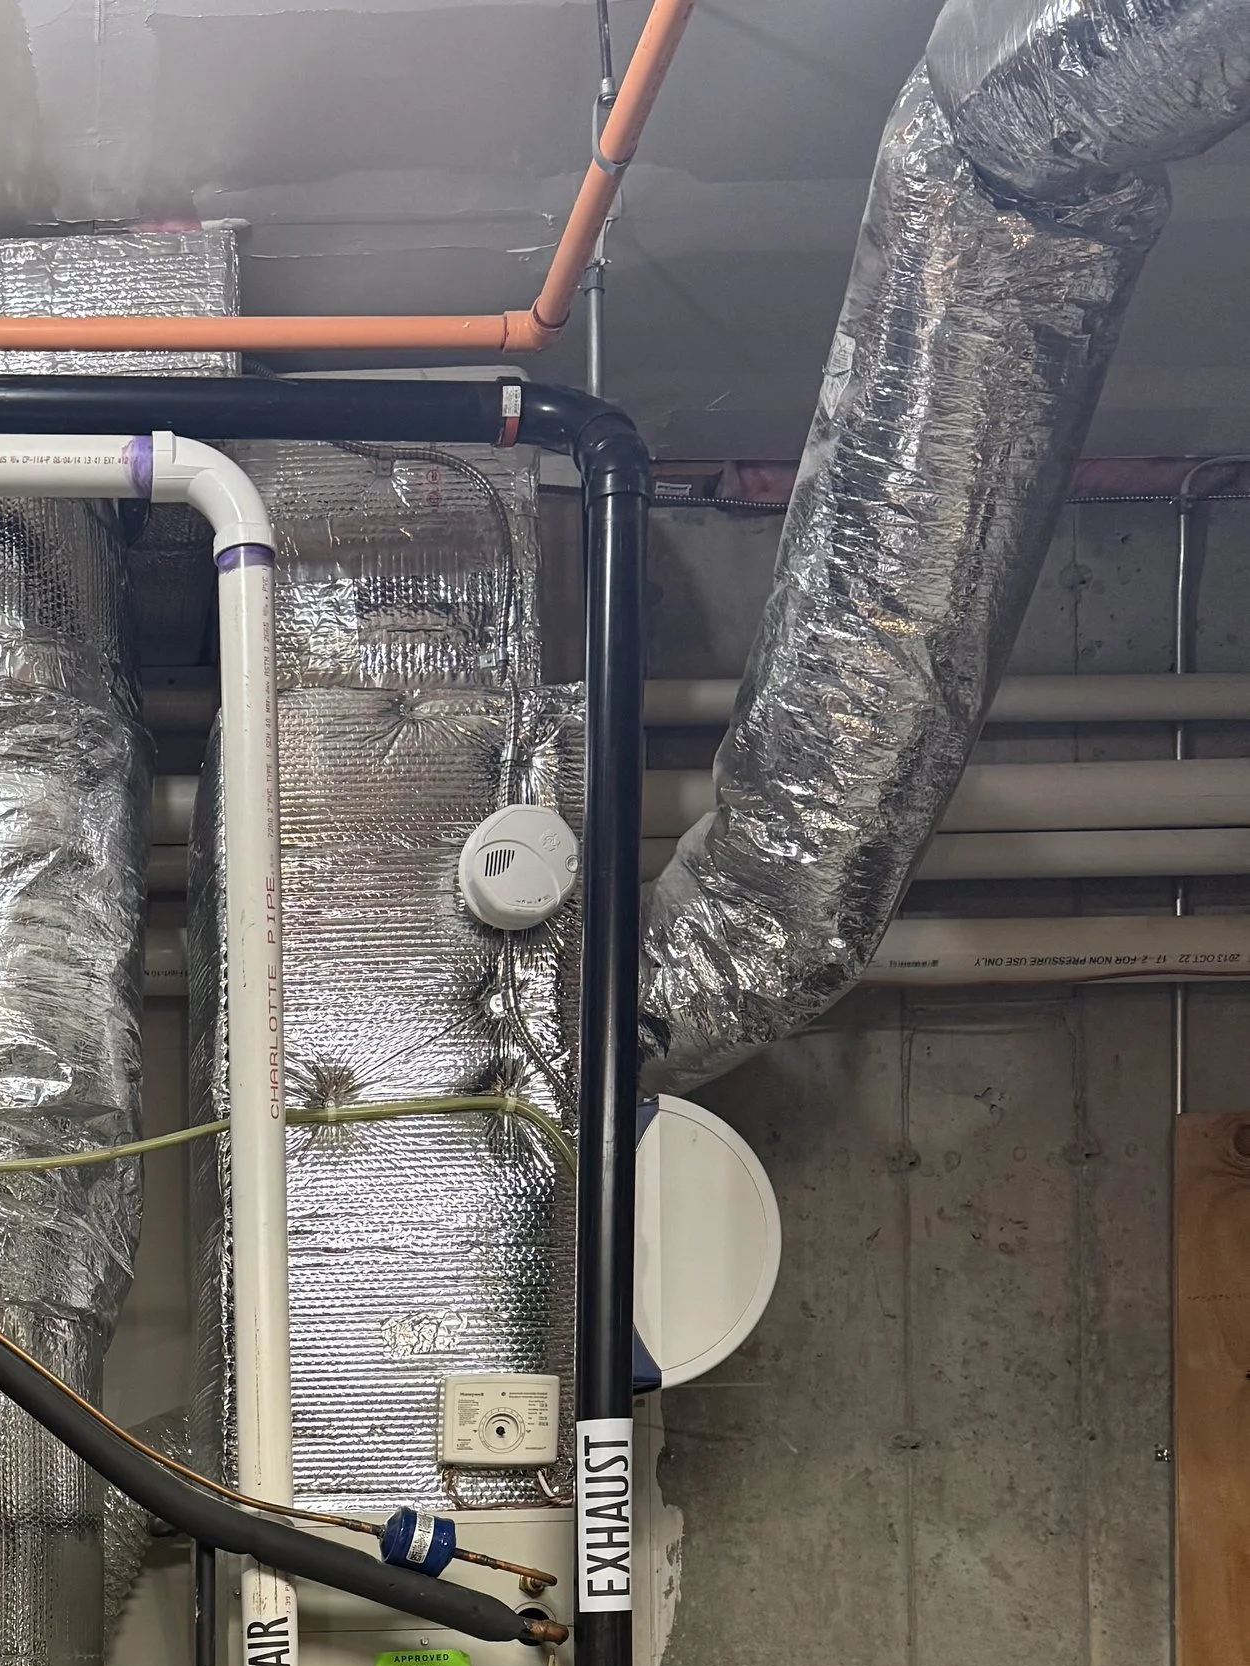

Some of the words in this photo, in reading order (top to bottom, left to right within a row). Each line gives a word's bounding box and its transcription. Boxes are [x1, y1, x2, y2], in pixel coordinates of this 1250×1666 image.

[265, 761, 273, 783] TYPE
[265, 876, 277, 944] PIPE
[974, 957, 1004, 967] ONLY
[1005, 957, 1027, 967] USE
[1029, 956, 1086, 966] PRESSURE
[1089, 956, 1112, 965] NON
[1178, 954, 1192, 964] 22
[1193, 954, 1216, 963] OCT
[1217, 953, 1241, 963] 2013
[267, 964, 280, 1119] CHARLOTTE
[583, 1435, 631, 1597] EXHAUST
[394, 1653, 449, 1663] APPROVED
